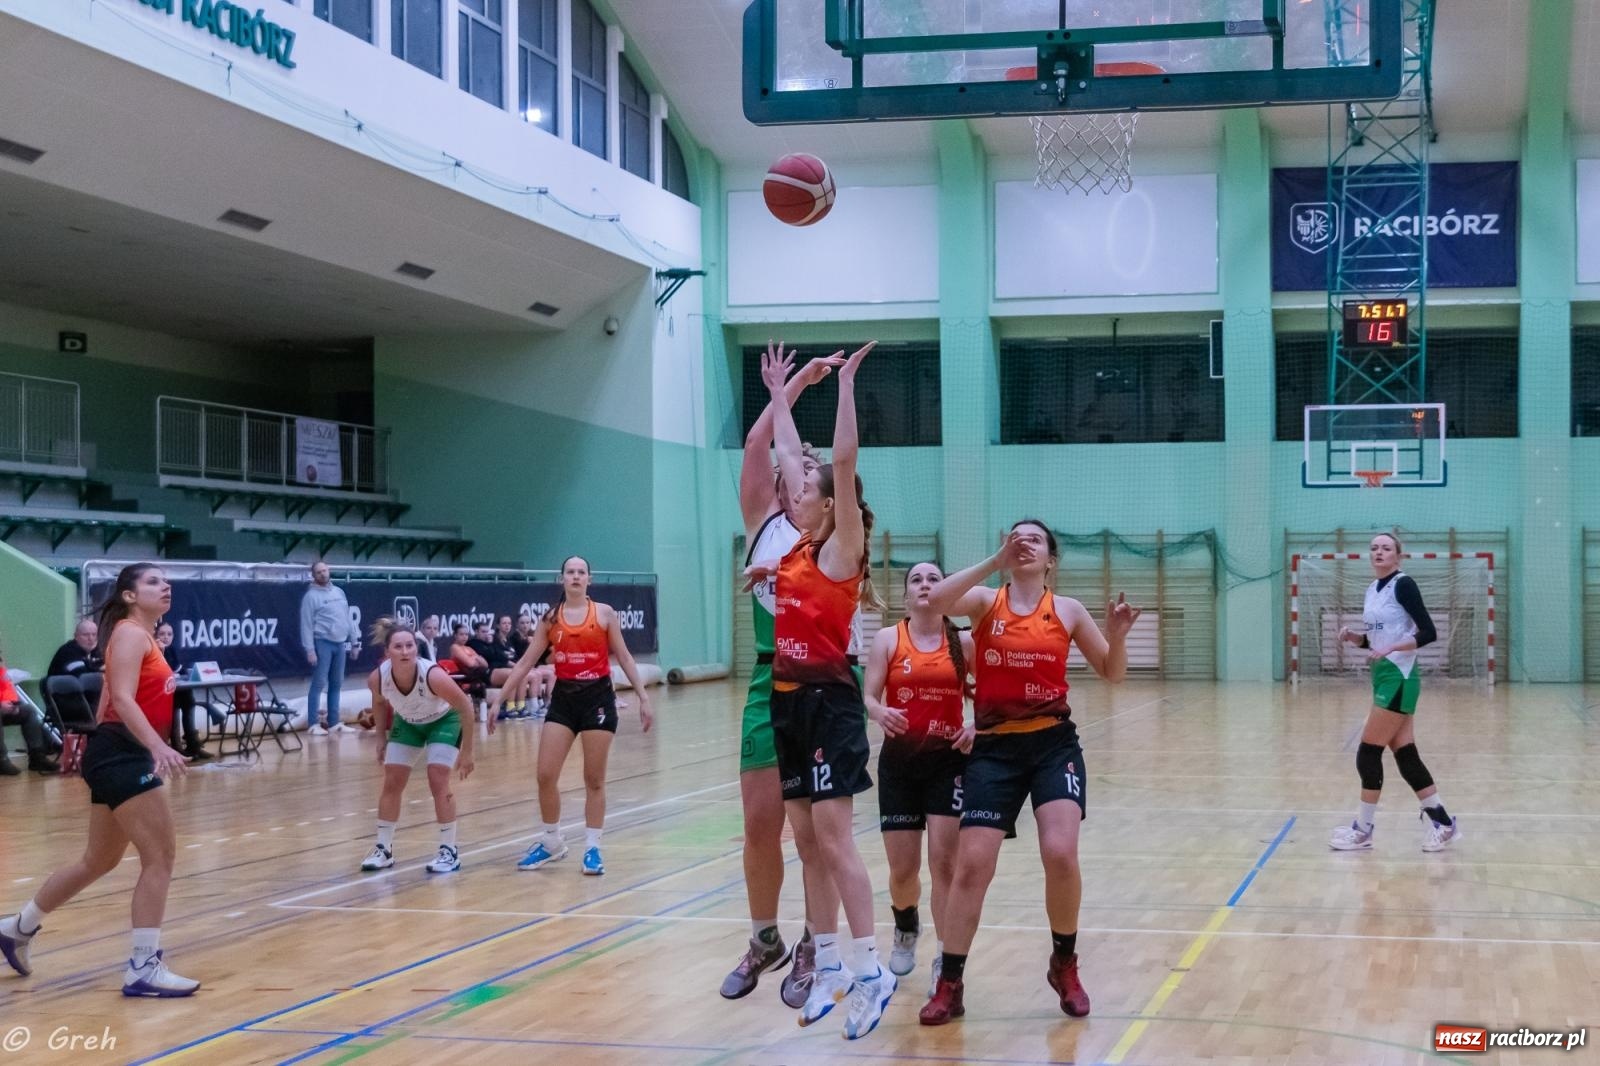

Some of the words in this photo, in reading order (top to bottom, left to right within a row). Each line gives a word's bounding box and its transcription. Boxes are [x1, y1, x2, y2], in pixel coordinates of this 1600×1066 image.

[1353, 208, 1499, 238] RACIBÓRZ
[1368, 322, 1391, 341] 16
[180, 609, 279, 648] RACIBÓRZ
[991, 619, 1006, 636] 15
[903, 658, 912, 674] 5
[1006, 650, 1057, 662] Politechnika
[811, 763, 833, 792] 12
[1064, 773, 1081, 797] 15
[951, 789, 964, 811] 5
[970, 809, 1001, 820] GROUP
